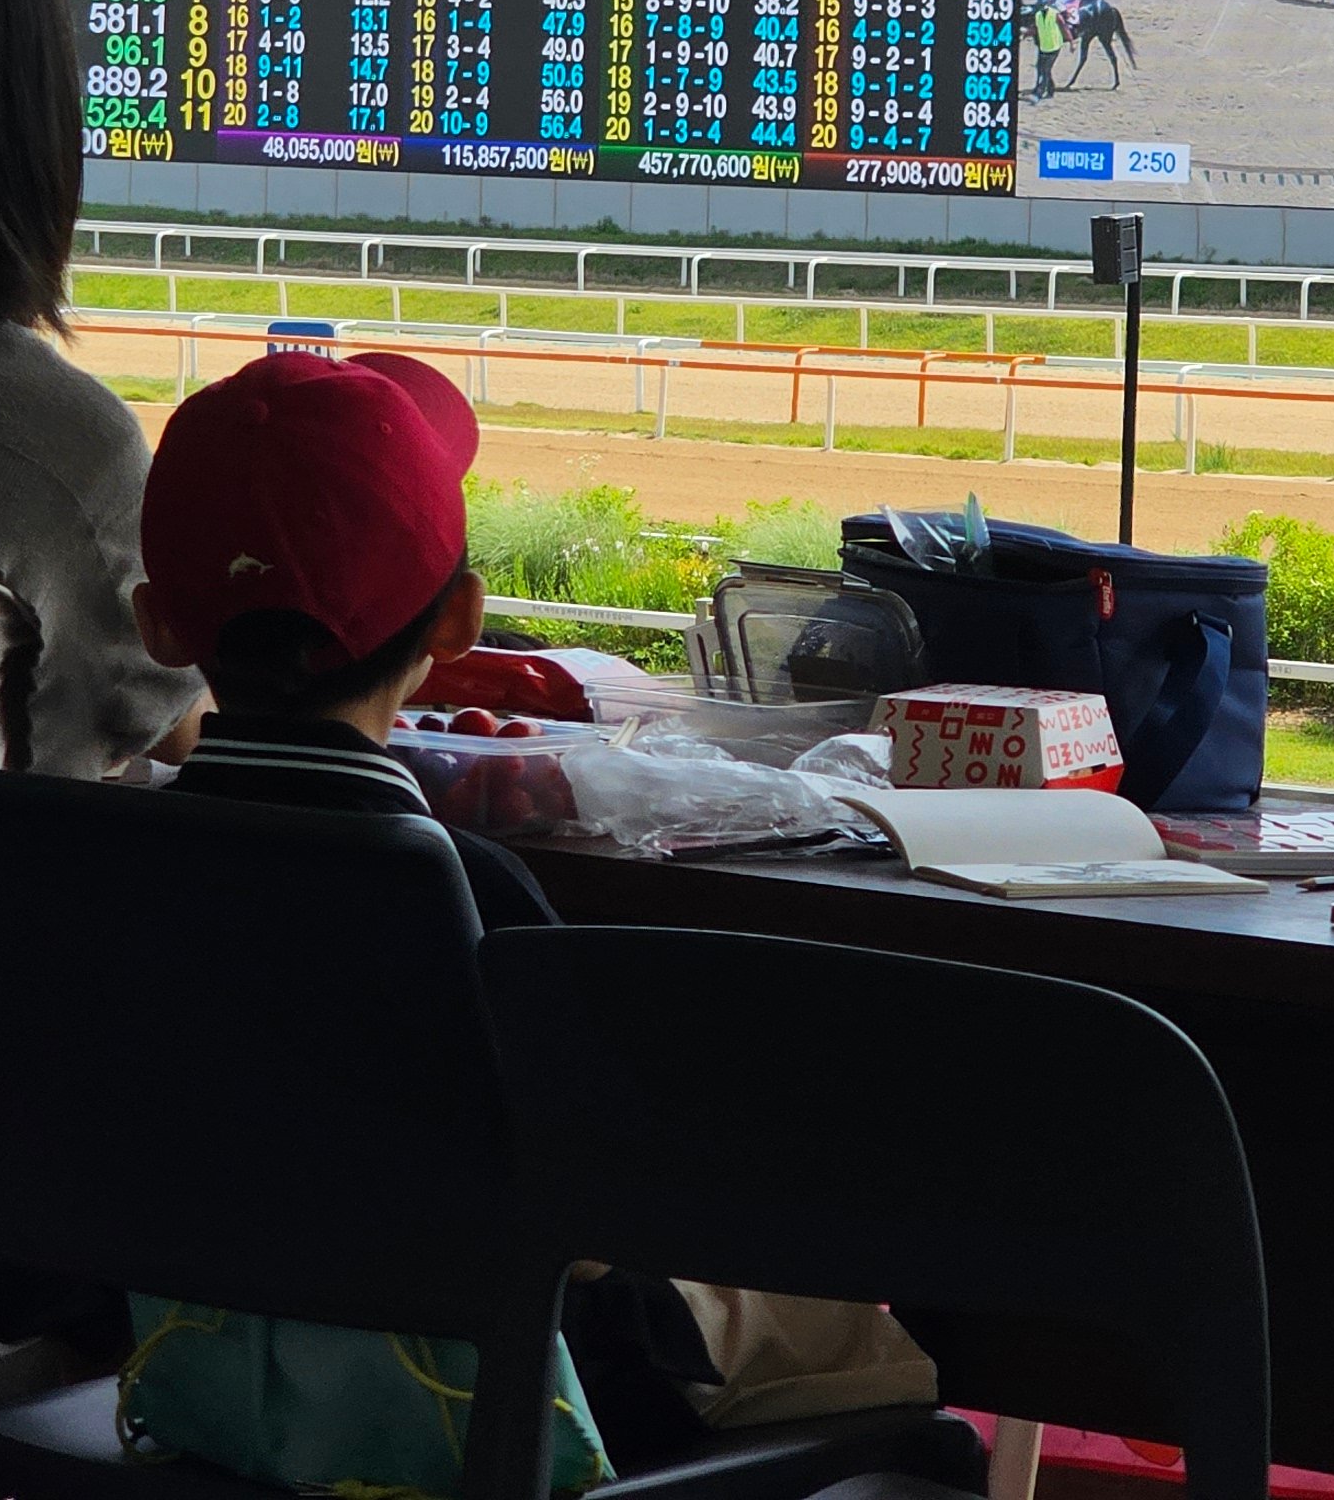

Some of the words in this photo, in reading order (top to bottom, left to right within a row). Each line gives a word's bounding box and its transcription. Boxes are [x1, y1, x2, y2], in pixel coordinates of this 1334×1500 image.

[86, 65, 167, 97] 889.2
[540, 115, 582, 139] 56.4
[1046, 151, 1104, 171] 발매마감
[1129, 151, 1176, 173] 2:50
